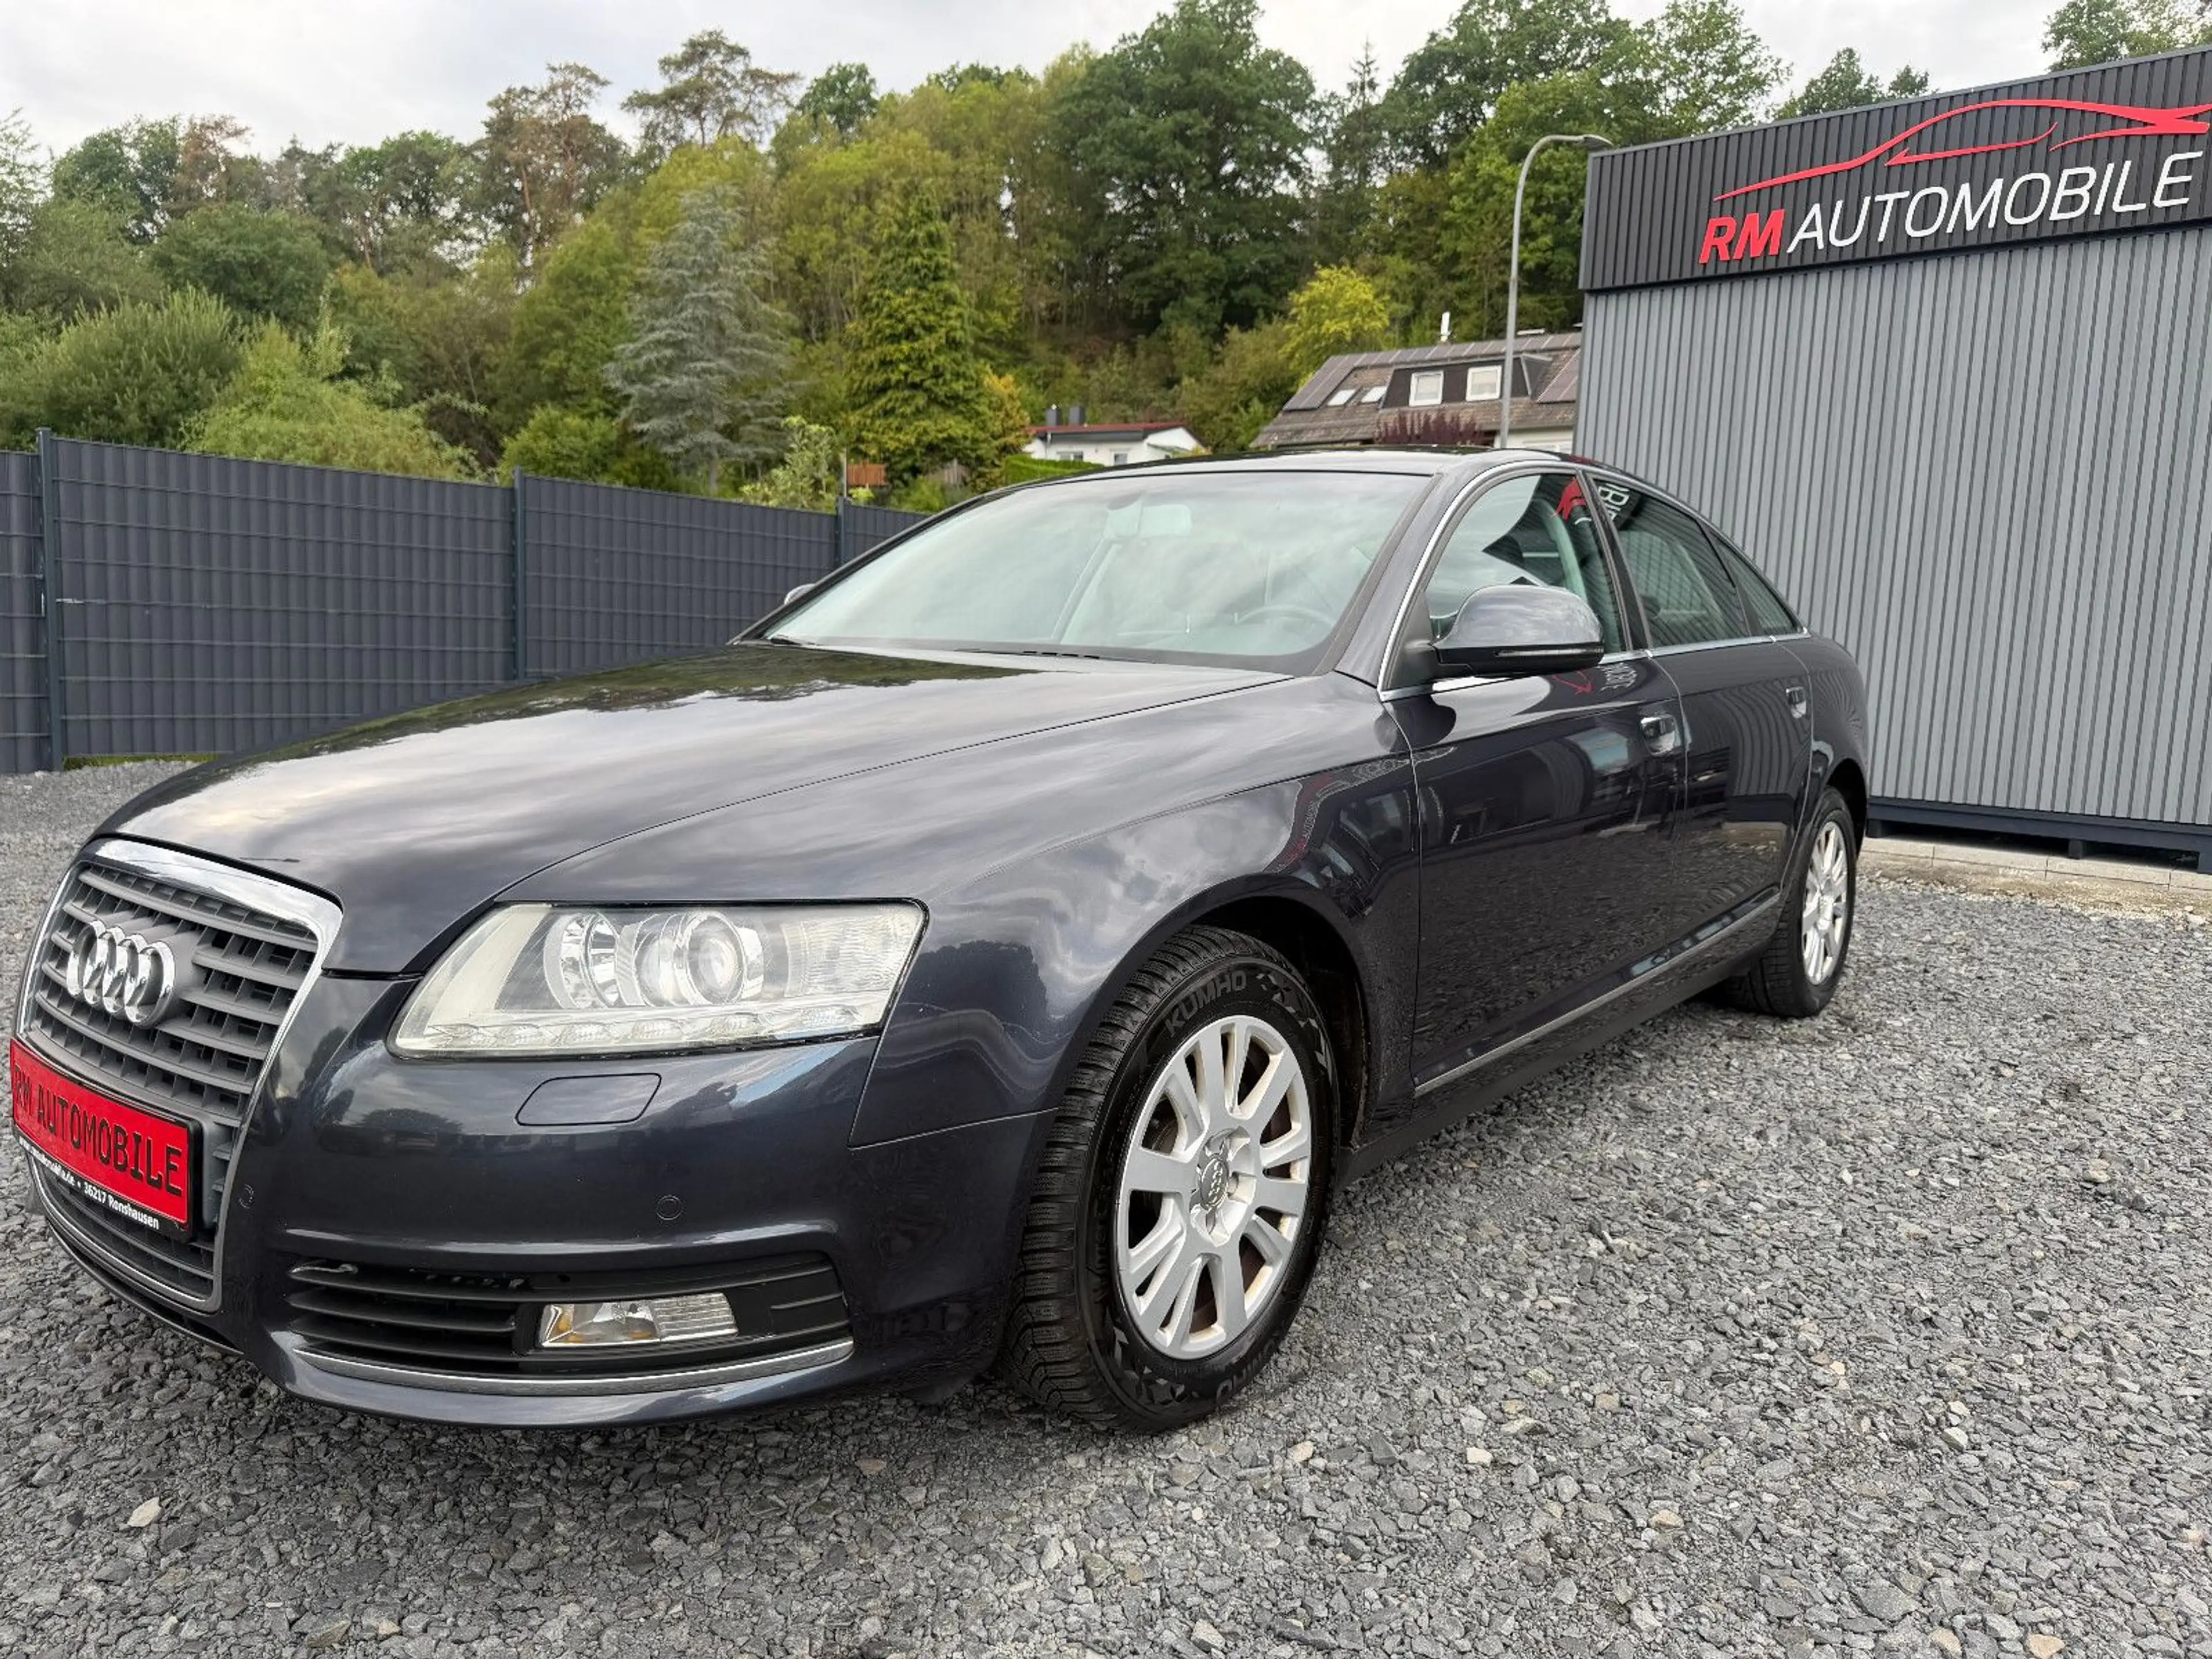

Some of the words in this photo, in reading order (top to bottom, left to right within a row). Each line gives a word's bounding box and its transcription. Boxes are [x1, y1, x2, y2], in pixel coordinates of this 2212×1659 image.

[1699, 209, 1786, 264] RM
[1786, 151, 2203, 253] AUTOMOBILE
[1164, 970, 1247, 1037] KUMHO
[14, 1062, 32, 1116] RM
[37, 1084, 183, 1196] AUTOMOBILE
[84, 1181, 107, 1204] 36217
